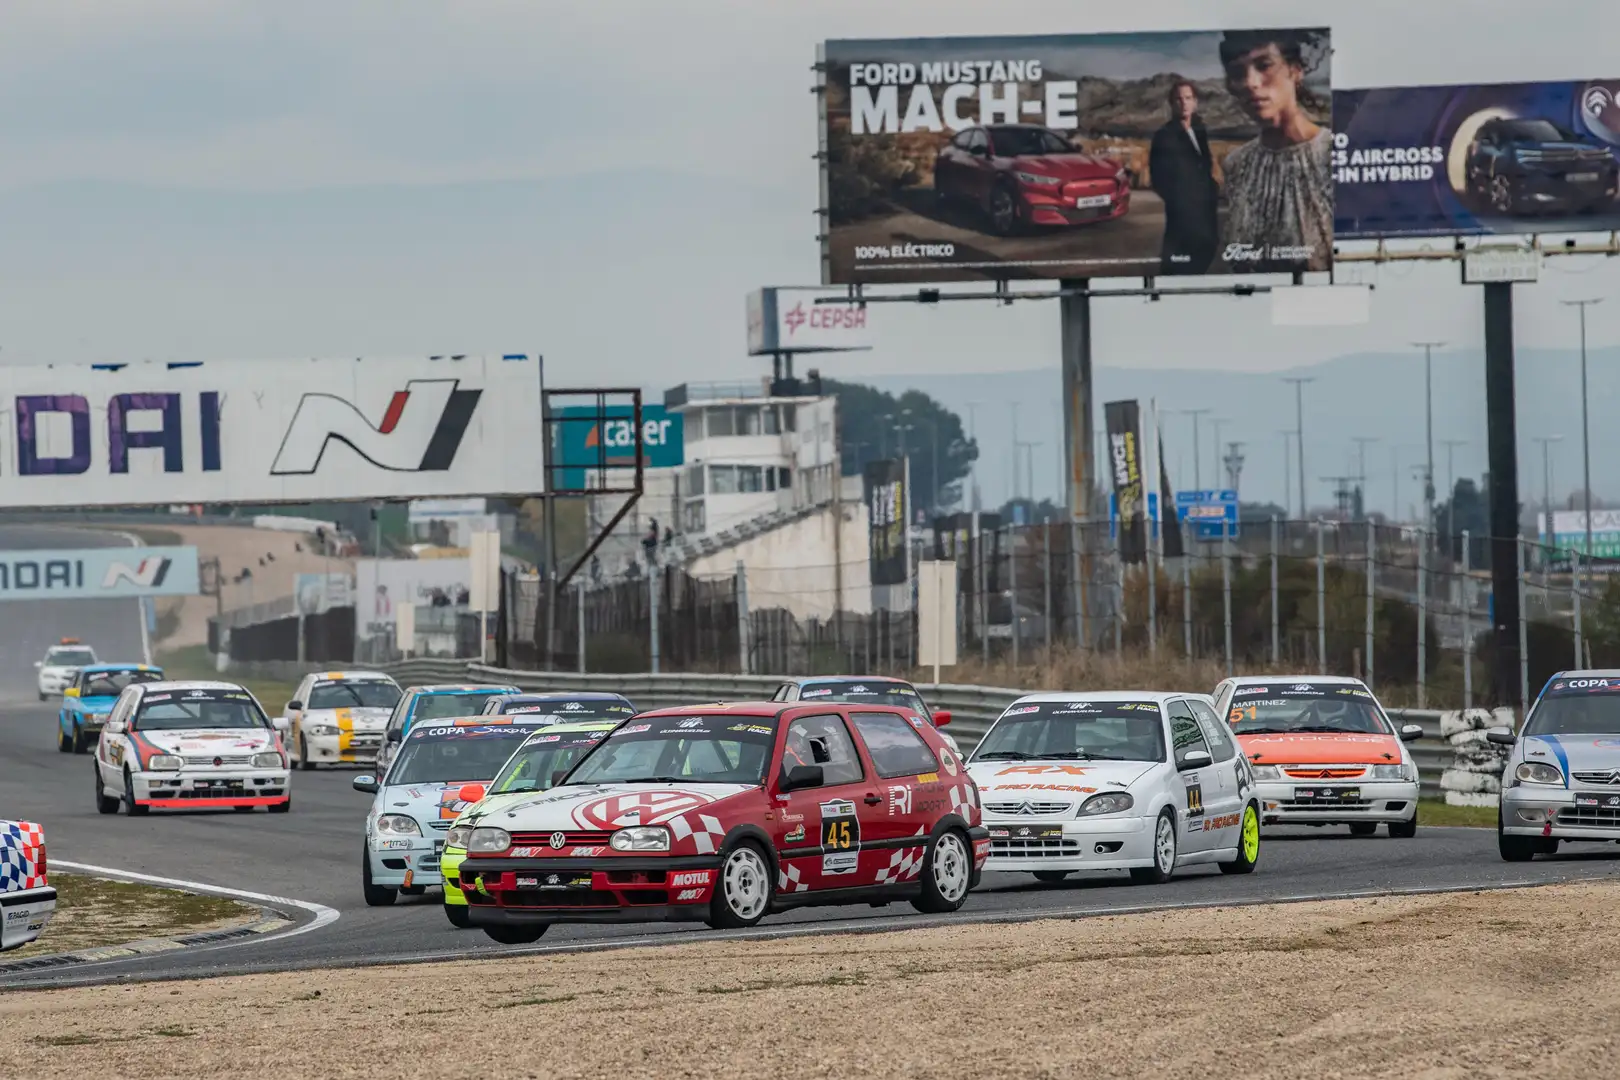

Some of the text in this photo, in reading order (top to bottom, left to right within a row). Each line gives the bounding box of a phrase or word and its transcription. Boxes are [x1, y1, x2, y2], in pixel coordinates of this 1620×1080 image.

[850, 60, 1042, 85] FORD MUSTANG
[850, 81, 1078, 134] MACH-E
[1350, 146, 1444, 166] AIRCROSS
[1362, 164, 1434, 182] HYBRID
[854, 242, 955, 259] 100% ELÉCTRICO
[1222, 243, 1264, 261] Ford
[810, 307, 867, 329] CEPSA
[1569, 679, 1609, 688] COPA
[1232, 700, 1287, 709] MARTINEZ
[1230, 706, 1257, 722] 51
[428, 727, 466, 736] COPA
[747, 728, 772, 736] RACE
[1031, 784, 1099, 794] RACING
[827, 821, 851, 849] 45
[672, 871, 710, 886] MOTUL
